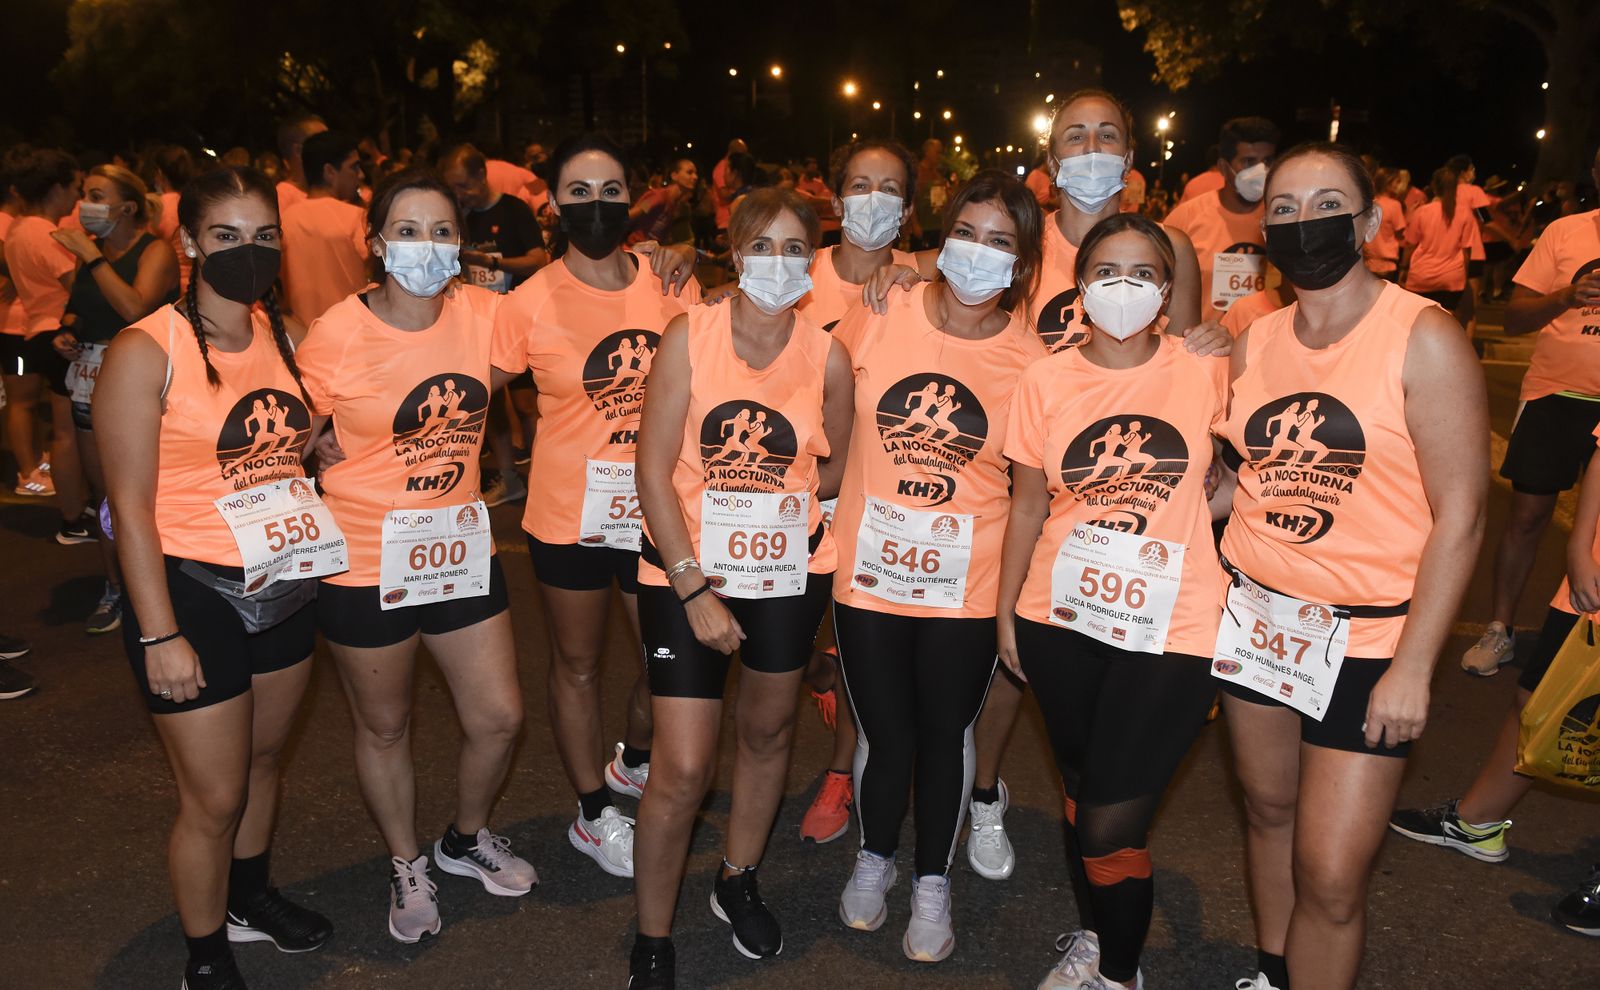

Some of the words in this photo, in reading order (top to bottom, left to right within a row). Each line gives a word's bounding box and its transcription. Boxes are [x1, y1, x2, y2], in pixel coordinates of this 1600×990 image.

[471, 270, 496, 283] 783
[1229, 274, 1265, 291] 646
[594, 400, 611, 412] LA
[605, 408, 618, 421] del
[395, 446, 411, 457] LA
[415, 434, 478, 451] NOCTURNA
[883, 441, 900, 453] LA
[902, 440, 967, 467] NOCTURNA
[243, 455, 300, 472] NOCTURN
[405, 455, 417, 467] del
[893, 454, 907, 466] del
[233, 477, 248, 491] del
[718, 469, 785, 489] NOCTURNA
[1258, 471, 1272, 484] LA
[1274, 470, 1353, 494] NOCTURNA
[1272, 484, 1341, 506] Guadalquivir
[264, 512, 320, 553] 558
[245, 554, 284, 575] INMACULADA
[318, 538, 345, 551] HUMANES
[409, 540, 467, 571] 600
[728, 531, 787, 560] 669
[881, 539, 941, 574] 546
[404, 575, 422, 583] MARI
[423, 572, 439, 581] RUIZ
[440, 569, 468, 578] ROMERO
[713, 562, 744, 573] ANTONIA
[746, 564, 773, 573] LUCENA
[775, 563, 796, 572] RUEDA
[862, 560, 882, 575] ROCÍO
[883, 568, 915, 584] NOGALES
[916, 576, 958, 585] GUTIÉRREZ
[1079, 566, 1148, 609] 596
[1065, 594, 1085, 608] LUCIA
[1086, 602, 1130, 622] RODRIGUEZ
[1132, 615, 1154, 625] REINA
[1249, 618, 1312, 665] 547
[1234, 647, 1254, 660] ROSI
[1255, 655, 1292, 676] HUMANES
[1292, 669, 1316, 687] ANGEL
